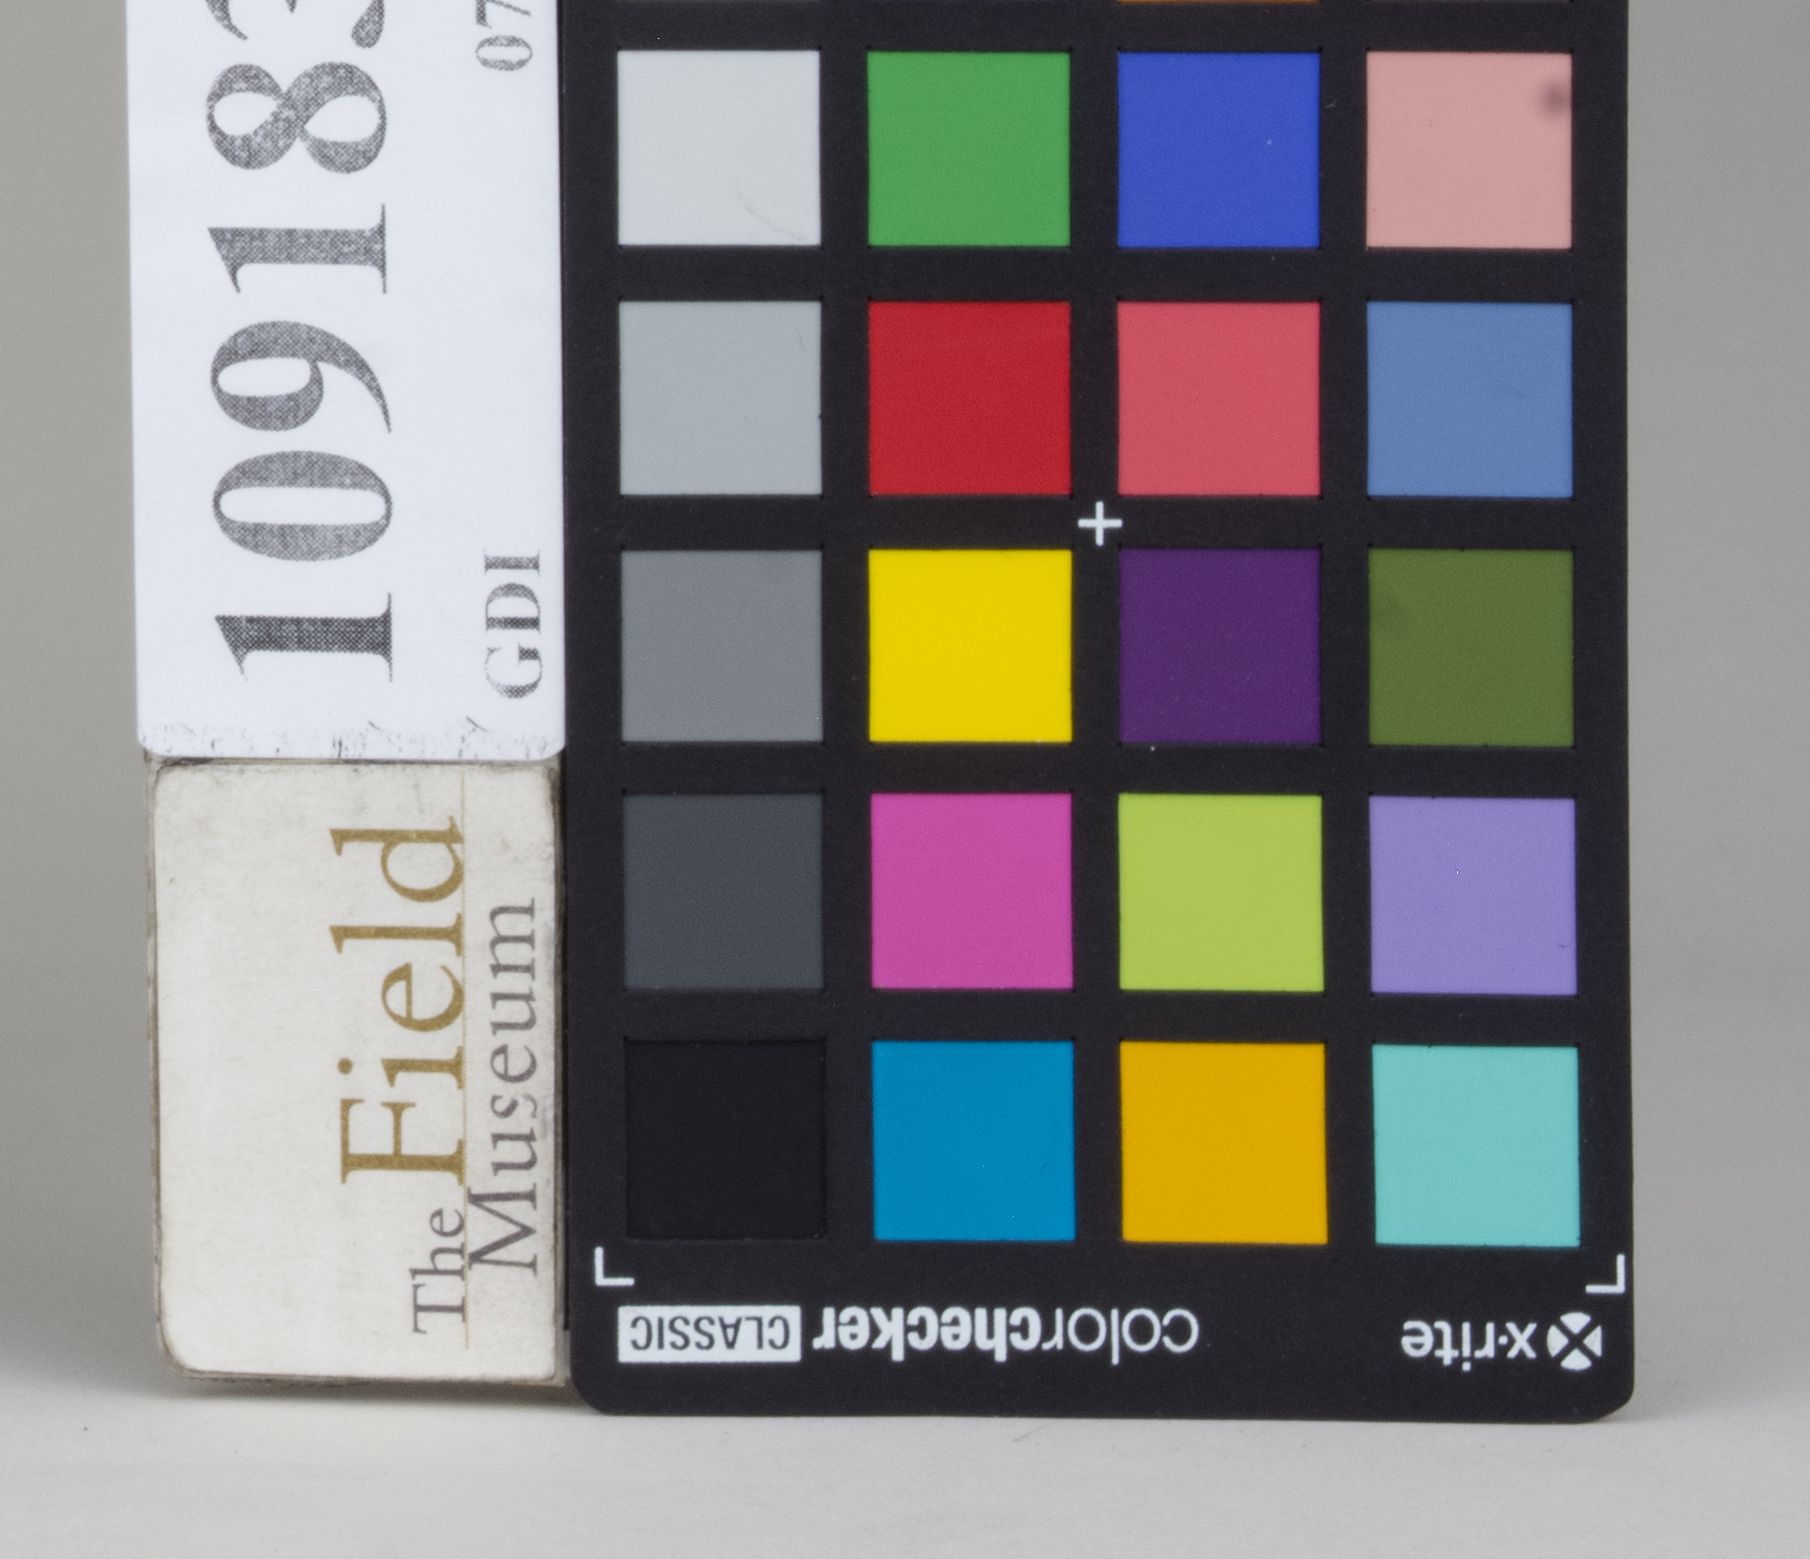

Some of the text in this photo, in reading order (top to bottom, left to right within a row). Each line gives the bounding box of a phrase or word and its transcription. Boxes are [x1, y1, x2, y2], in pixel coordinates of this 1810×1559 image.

[483, 549, 543, 700] GDI
[329, 815, 467, 1334] The Field
[466, 897, 538, 1275] Museum
[629, 1305, 1199, 1365] colorchecker CLASSIC
